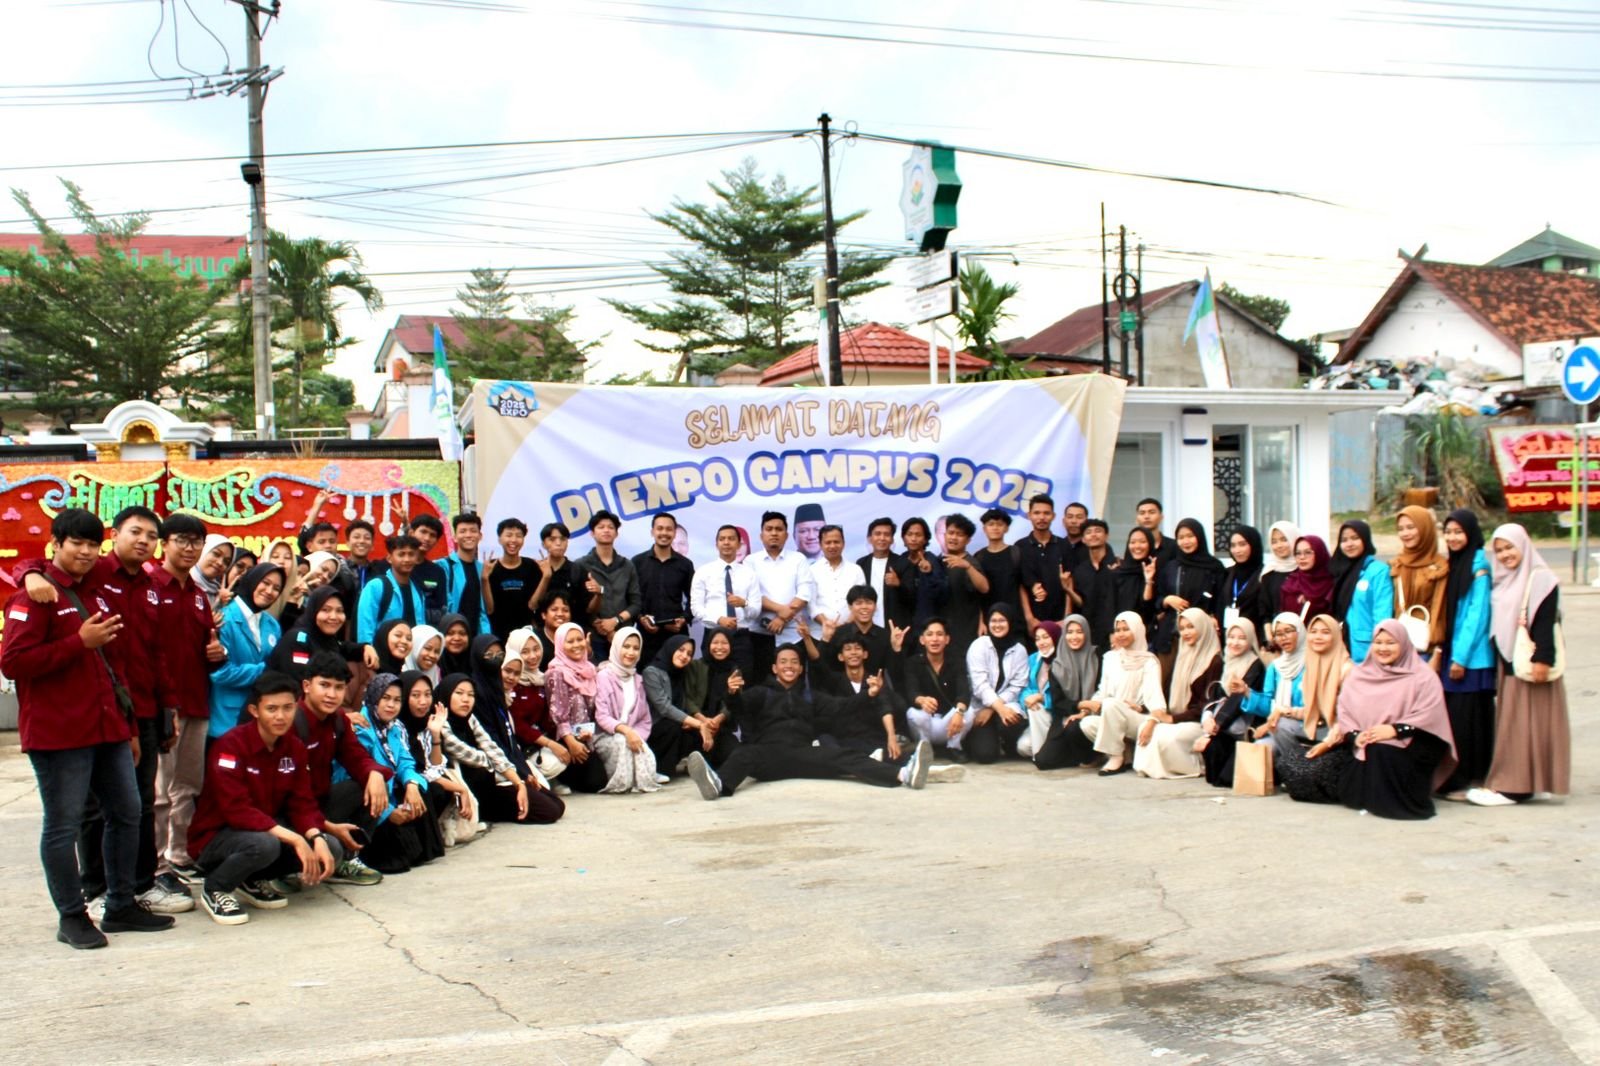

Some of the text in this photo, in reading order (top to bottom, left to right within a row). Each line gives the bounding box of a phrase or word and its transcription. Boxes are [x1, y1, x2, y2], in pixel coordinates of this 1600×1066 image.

[500, 399, 526, 410] 2025
[500, 407, 528, 417] EXPO
[685, 399, 942, 449] SELAMAT DATANG
[165, 474, 256, 519] SUKSES
[553, 485, 607, 537] DI
[612, 459, 736, 518] EXPO
[747, 451, 937, 496] CAMPUS
